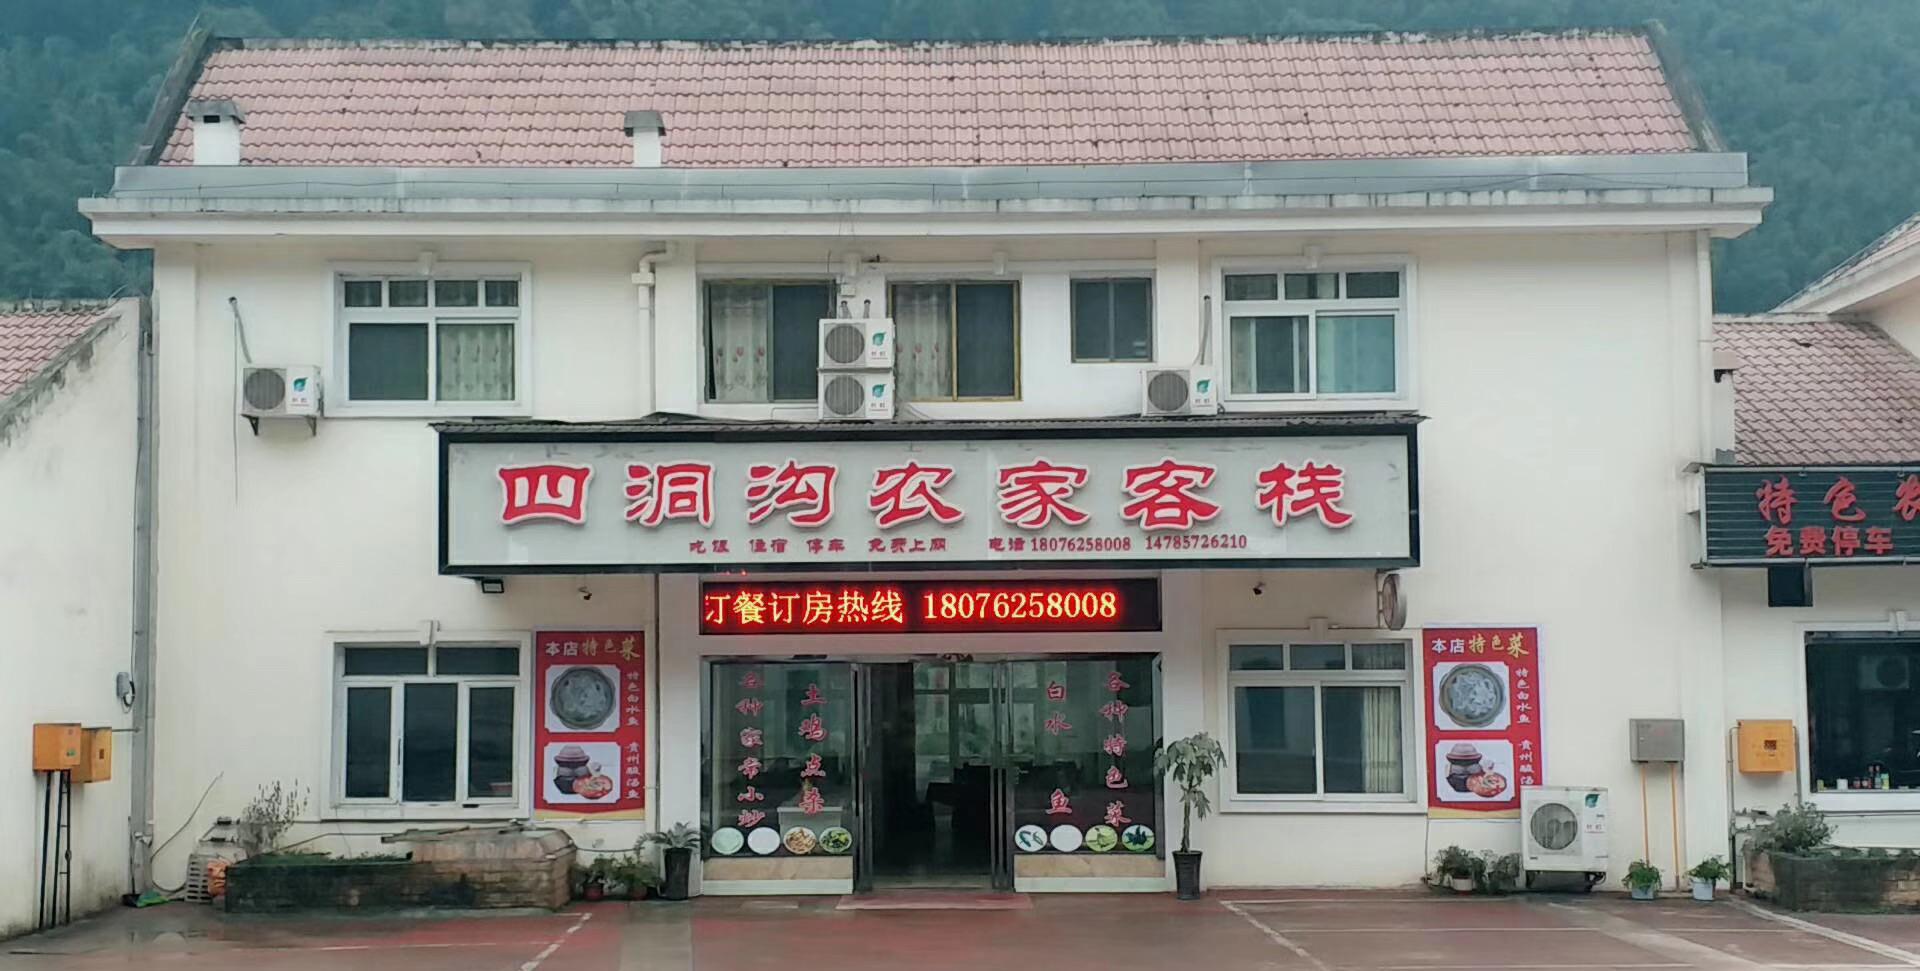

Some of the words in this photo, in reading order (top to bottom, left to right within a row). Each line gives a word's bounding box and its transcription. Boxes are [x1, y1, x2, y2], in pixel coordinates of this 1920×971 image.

[498, 457, 1354, 531] 四洞沟农家客栈
[690, 539, 730, 554] 吃饭
[750, 538, 788, 554] 住宿
[806, 538, 845, 554] 停车
[868, 537, 947, 554] 免费上网
[988, 537, 1025, 552] 电话
[1030, 537, 1132, 552] 18076258008
[1144, 534, 1248, 550] 14785726210
[1765, 525, 1893, 557] 免费停车
[924, 591, 1117, 619] 18076258008
[545, 635, 640, 661] 本店特色菜
[1432, 632, 1529, 658] 本店特色菜
[1099, 671, 1131, 828] 各种特色菜
